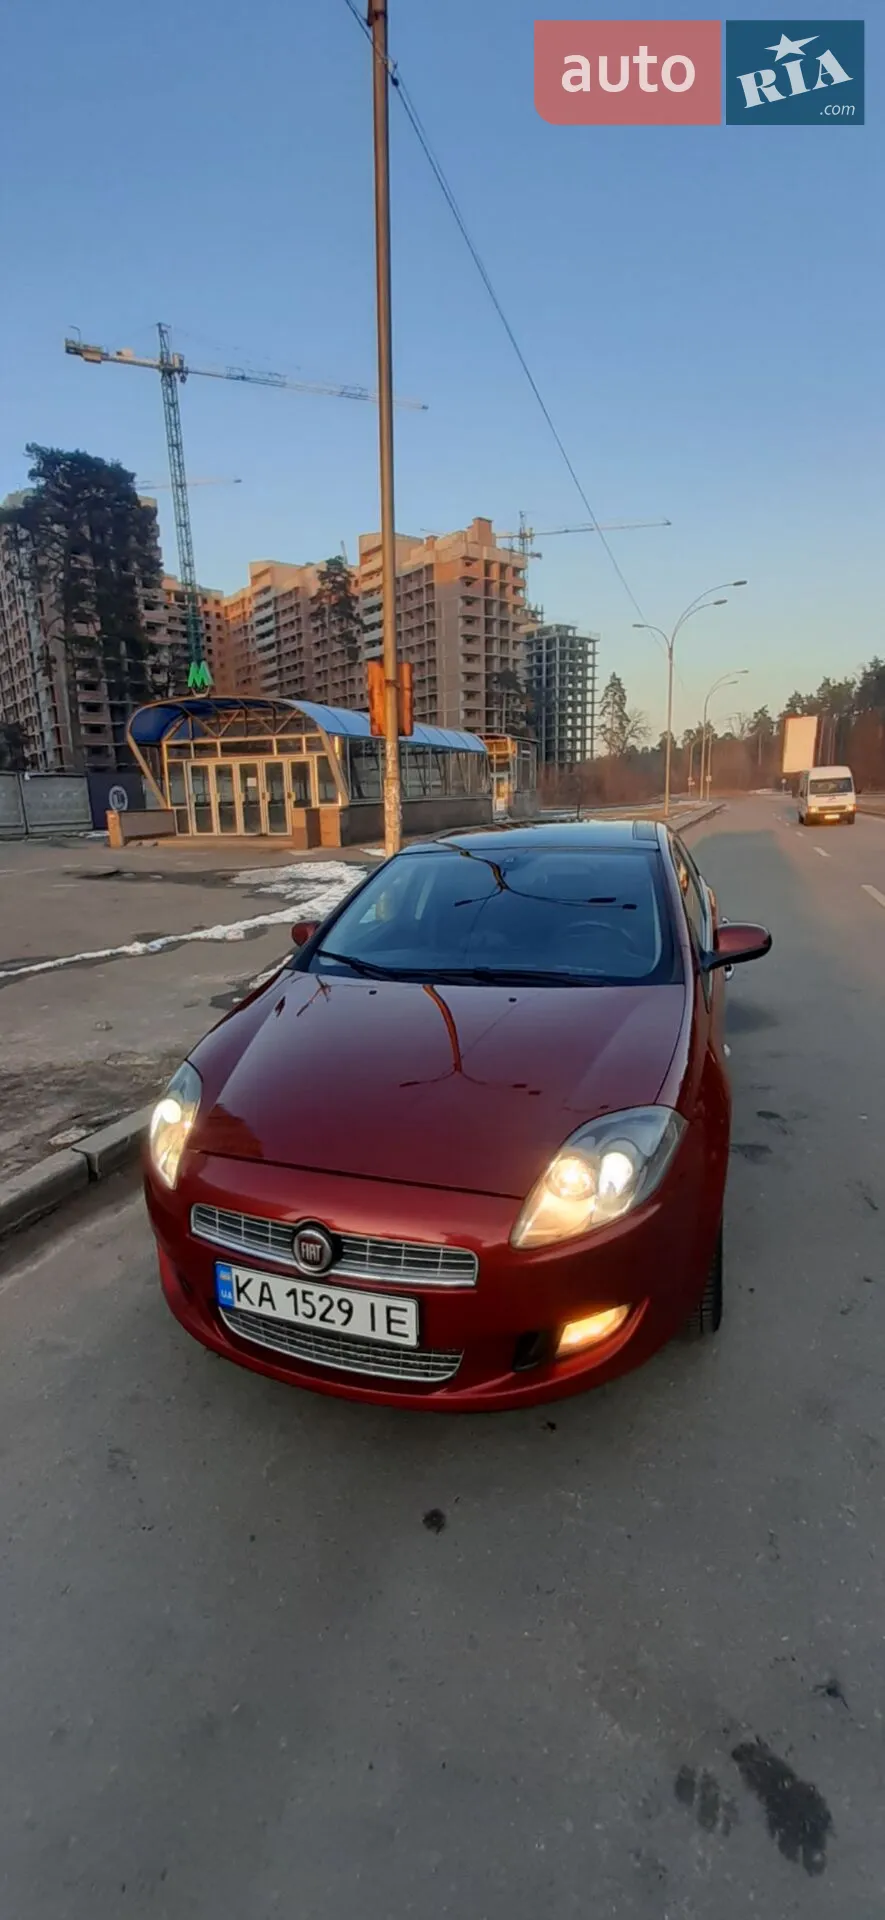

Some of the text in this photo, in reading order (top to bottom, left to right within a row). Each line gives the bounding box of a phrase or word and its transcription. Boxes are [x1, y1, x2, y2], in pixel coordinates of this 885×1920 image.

[301, 1242, 321, 1261] FIAT
[220, 1288, 233, 1300] UA
[235, 1274, 410, 1339] KA 1529 IE
